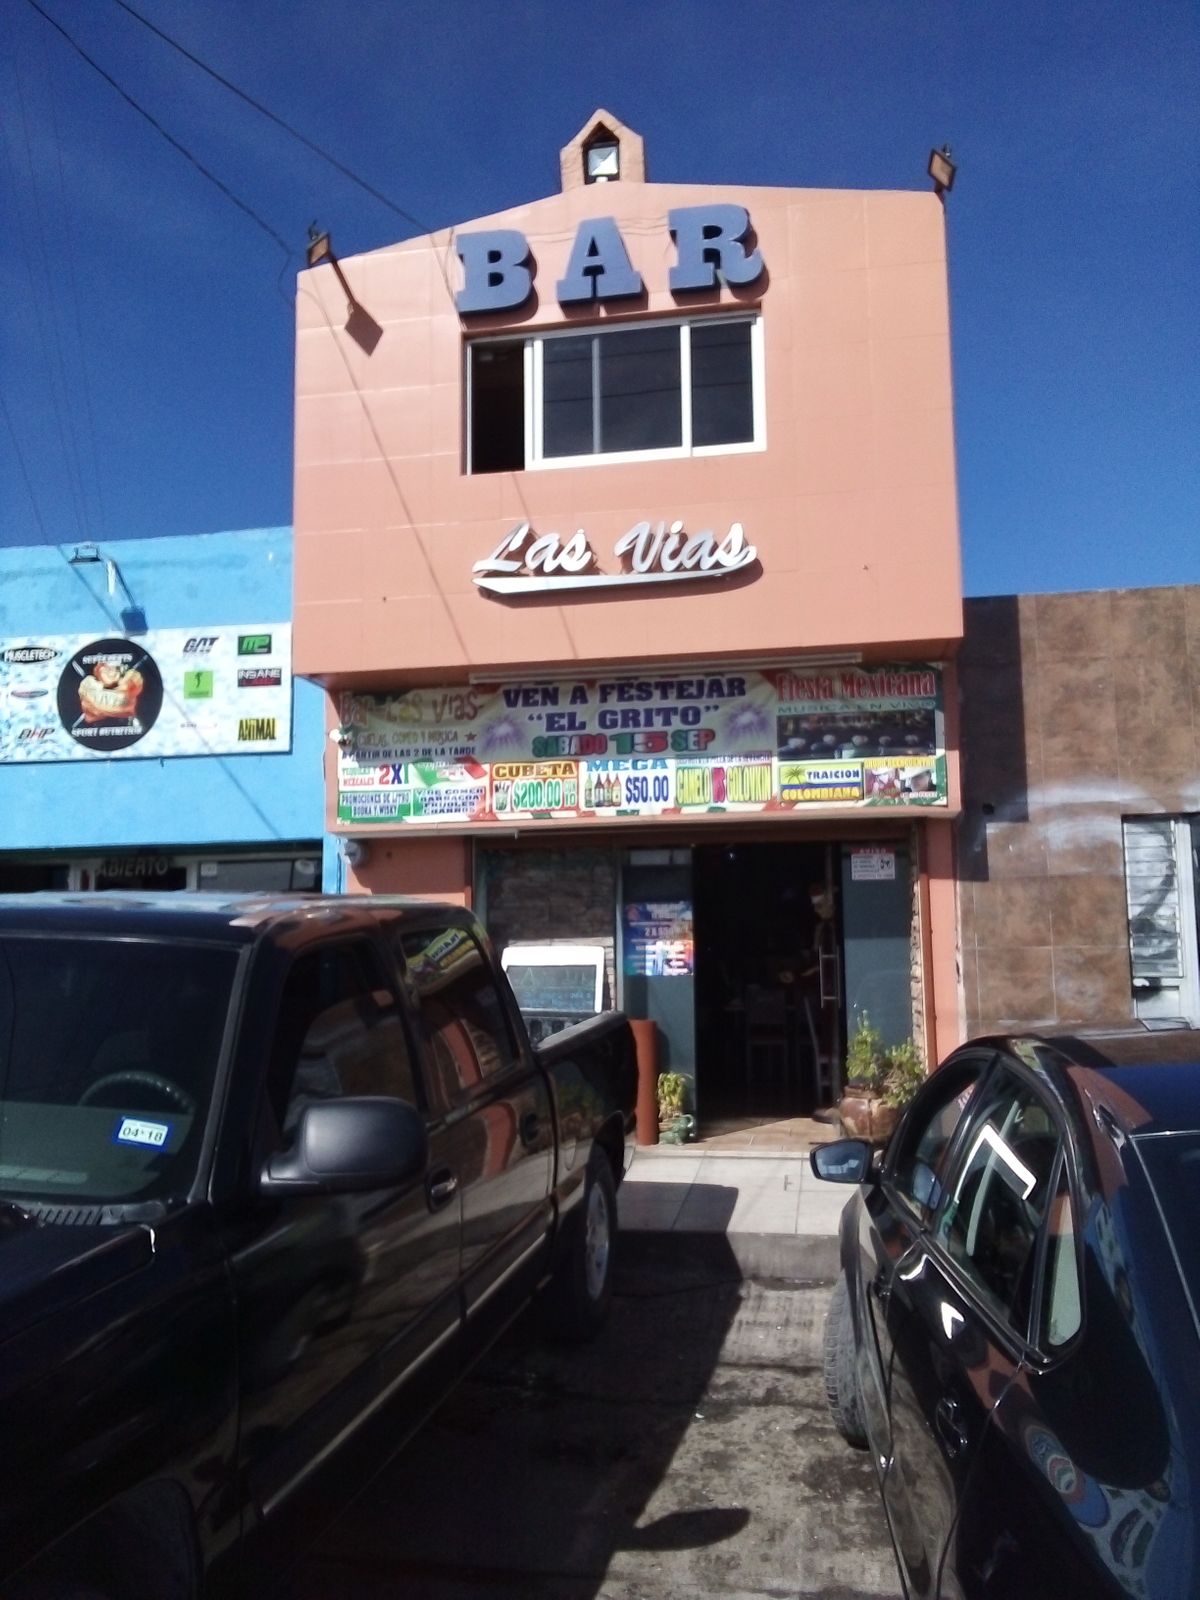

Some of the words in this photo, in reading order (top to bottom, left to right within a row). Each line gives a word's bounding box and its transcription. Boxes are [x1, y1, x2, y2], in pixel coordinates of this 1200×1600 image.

[456, 204, 766, 314] BAR
[472, 522, 590, 573] Las
[614, 520, 757, 573] Vias
[183, 637, 219, 653] GAT
[238, 669, 281, 679] INSANE
[502, 685, 559, 708] VEN
[569, 685, 588, 705] A
[600, 677, 746, 703] FESTEJAR
[777, 672, 833, 701] Fiesta
[841, 669, 936, 698] Mexicana
[778, 703, 848, 713] MUSICA
[858, 702, 882, 710] EN
[889, 701, 936, 709] VIVO
[238, 718, 276, 740] ANIMAL
[395, 749, 411, 758] LAS
[413, 748, 420, 757] 2
[422, 748, 433, 756] DE
[435, 747, 446, 756] LA
[449, 746, 476, 756] TARDE
[532, 733, 608, 757] SABADO
[609, 731, 668, 754] 15
[670, 729, 716, 752] SEP
[494, 763, 575, 778] CUBETA
[586, 759, 669, 771] MEGA
[807, 769, 860, 780] TRAICION
[513, 780, 562, 809] $200.00
[625, 775, 669, 805] $50.00
[782, 787, 860, 800] COLOMBIANA
[97, 857, 168, 877] ABIERTO
